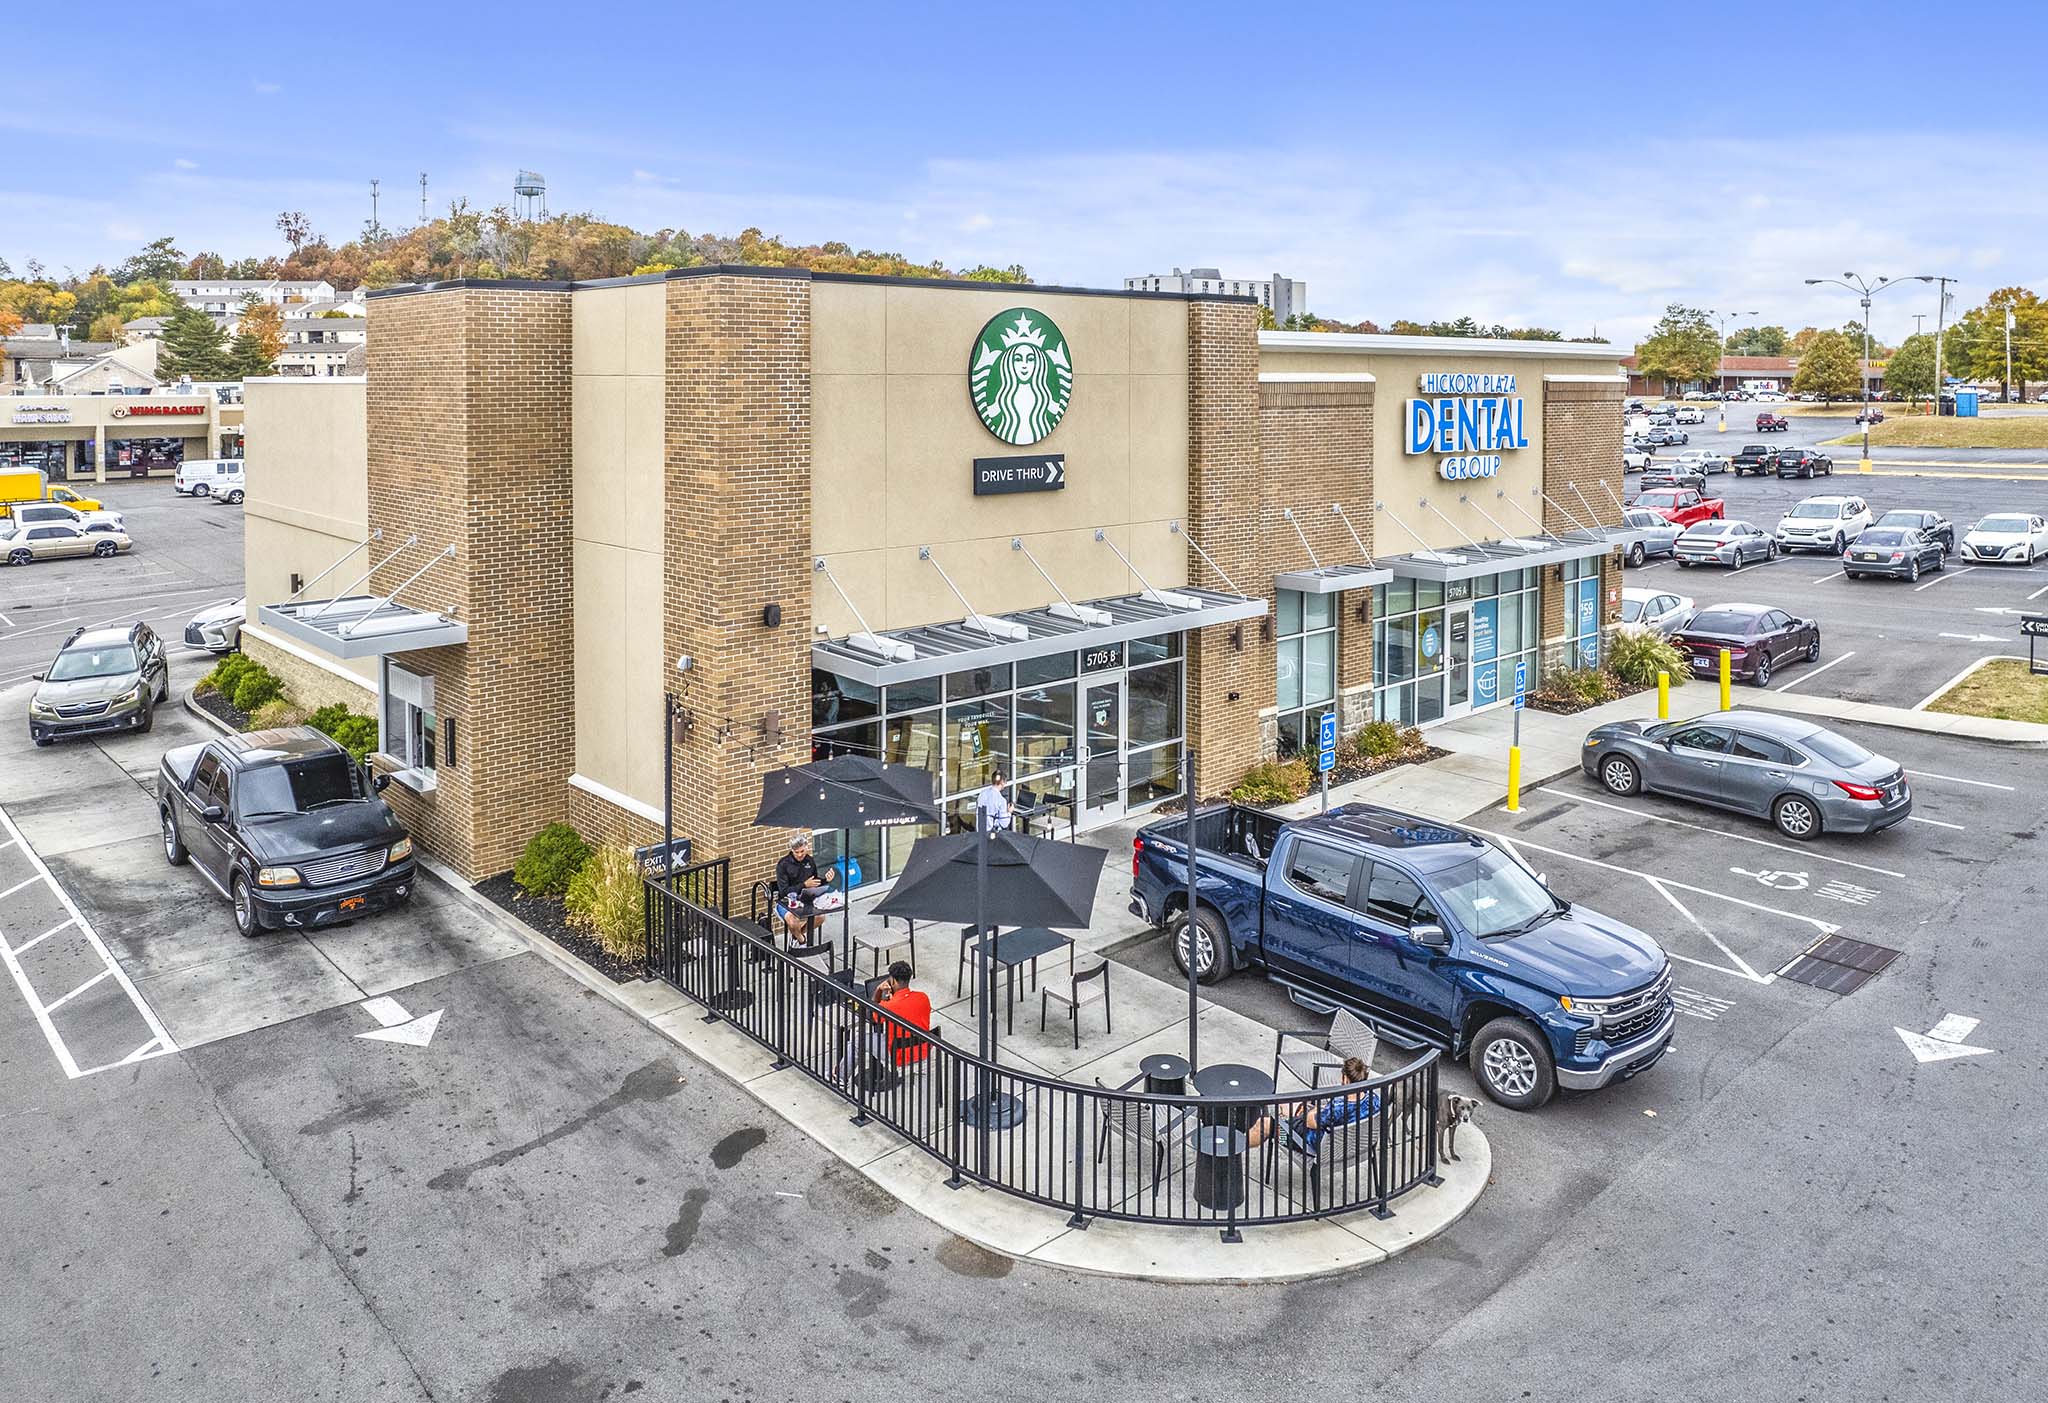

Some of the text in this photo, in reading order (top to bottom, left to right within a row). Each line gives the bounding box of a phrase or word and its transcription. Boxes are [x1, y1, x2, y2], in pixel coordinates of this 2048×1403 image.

[1427, 374, 1517, 393] HICKORY PLAZA
[1759, 381, 1773, 390] FedEx
[1409, 397, 1529, 454] DENTAL
[982, 467, 1044, 482] DRIVE THRU
[1446, 456, 1501, 480] GROUP
[1449, 586, 1467, 598] 5705 A
[1087, 650, 1116, 667] 5705 B
[644, 854, 664, 867] EXIT
[1470, 950, 1509, 968] SILVERADO
